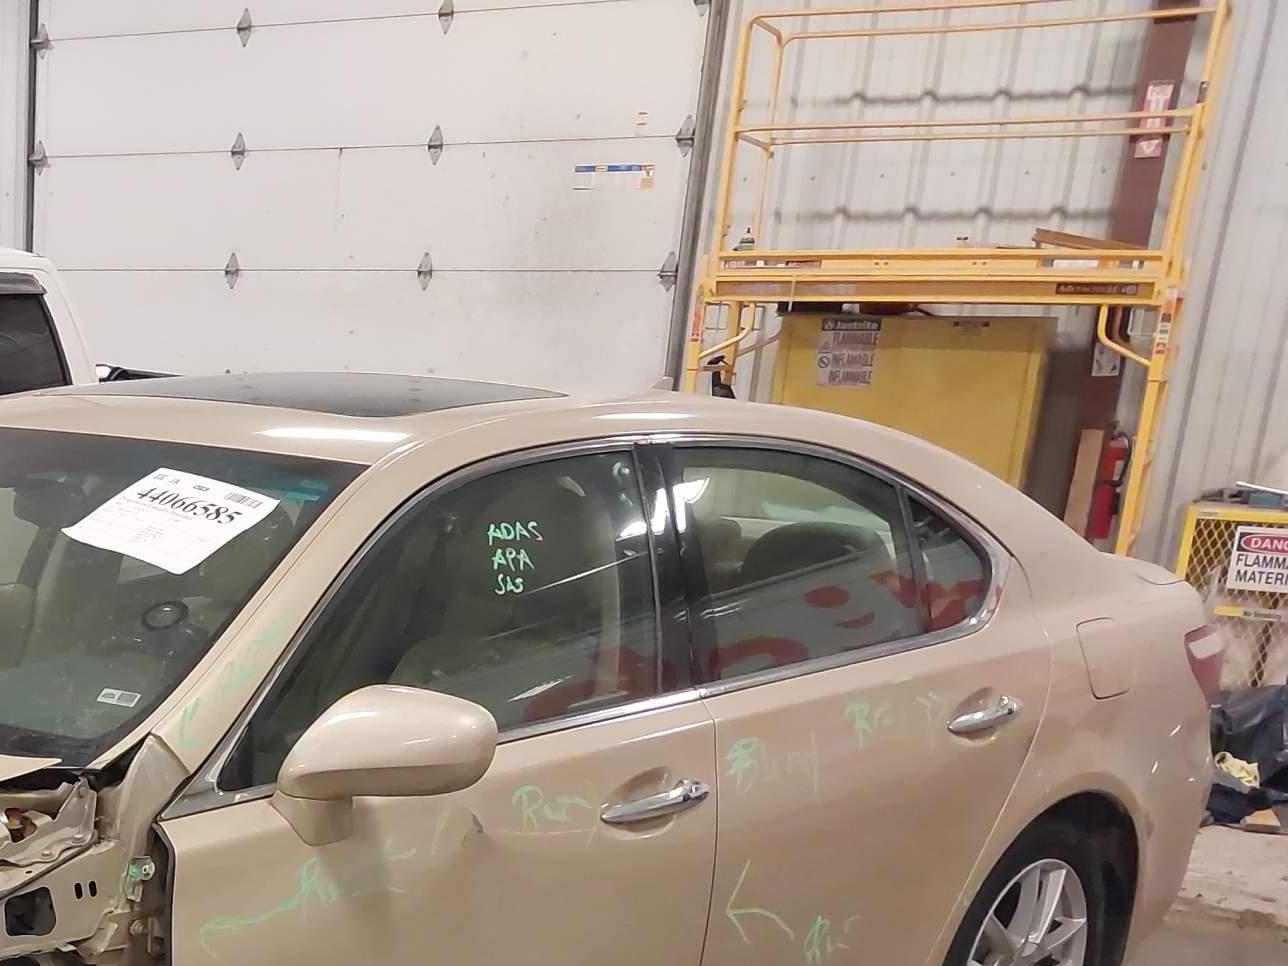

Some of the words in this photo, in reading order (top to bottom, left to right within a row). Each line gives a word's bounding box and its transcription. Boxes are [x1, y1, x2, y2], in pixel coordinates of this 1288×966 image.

[136, 487, 244, 525] 44066585
[487, 520, 544, 547] ADAS
[491, 547, 536, 572] APA
[1235, 553, 1288, 570] FLAMM
